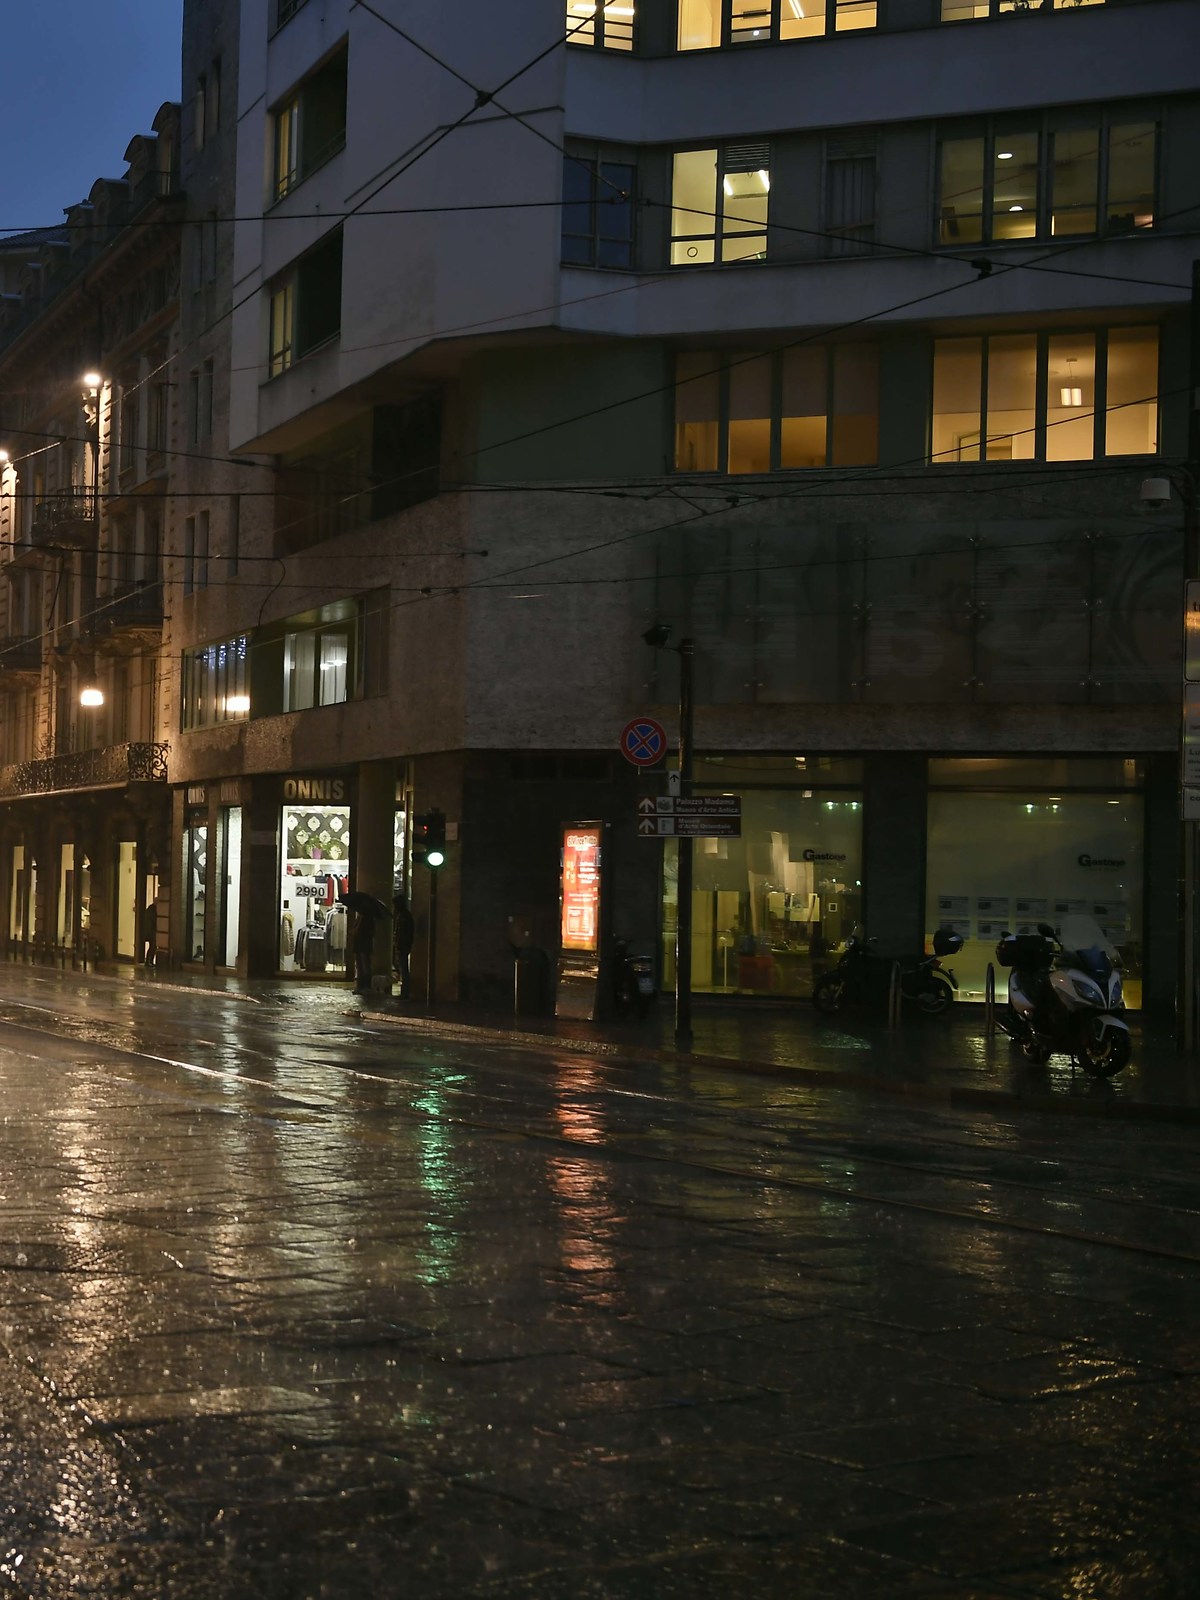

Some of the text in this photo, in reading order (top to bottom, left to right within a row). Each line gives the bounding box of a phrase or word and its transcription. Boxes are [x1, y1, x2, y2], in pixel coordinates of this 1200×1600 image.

[284, 779, 345, 800] ONNIS
[803, 849, 847, 861] Gastone
[1078, 854, 1126, 867] Gastone
